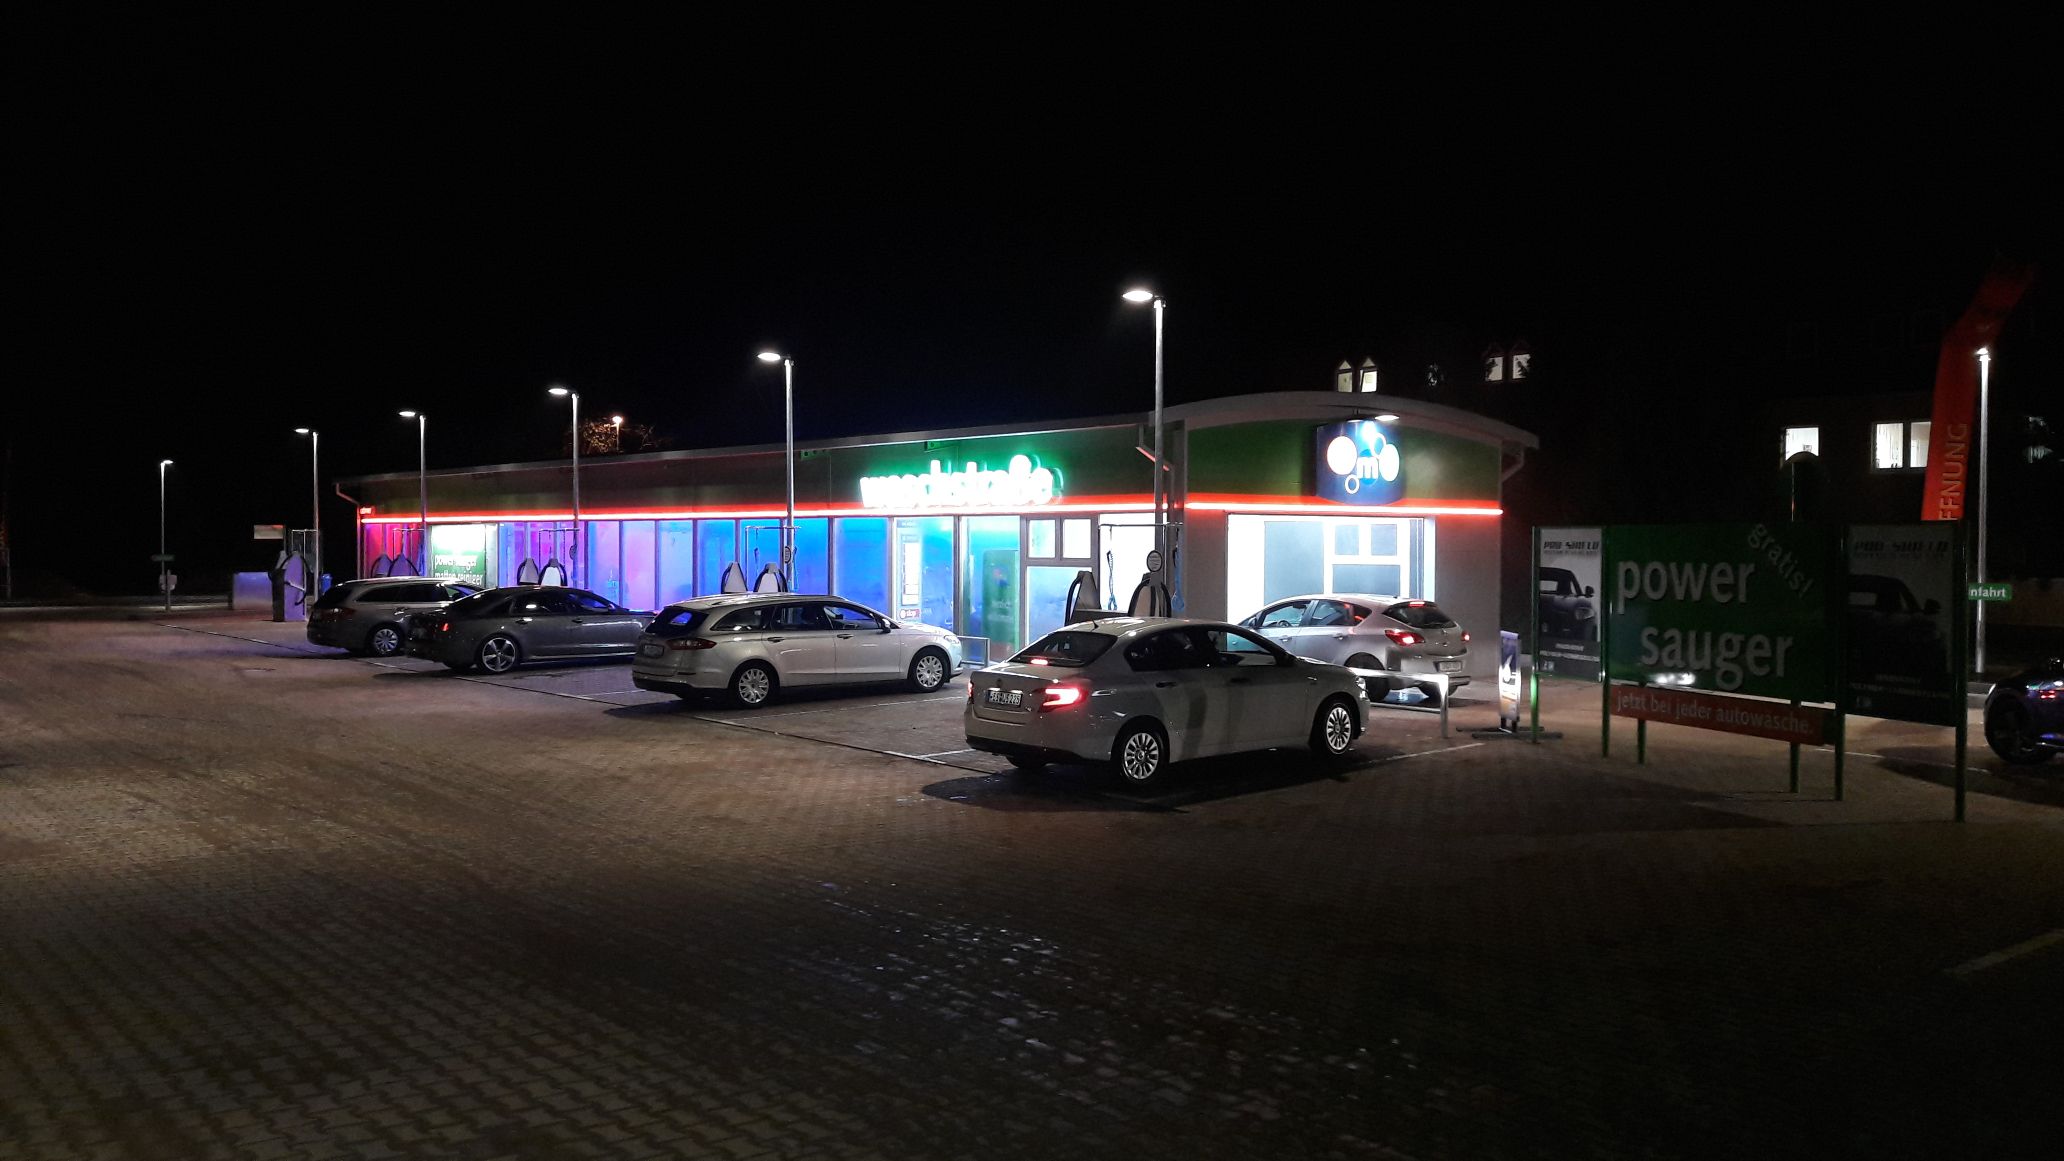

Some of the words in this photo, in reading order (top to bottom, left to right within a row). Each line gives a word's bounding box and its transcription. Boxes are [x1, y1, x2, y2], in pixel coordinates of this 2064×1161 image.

[1617, 560, 1756, 614] power
[1747, 523, 1815, 598] gratis!
[1640, 626, 1793, 691] sauger
[1616, 690, 1648, 712] jetzt
[1651, 695, 1672, 713] bei
[1675, 700, 1712, 720] jeder
